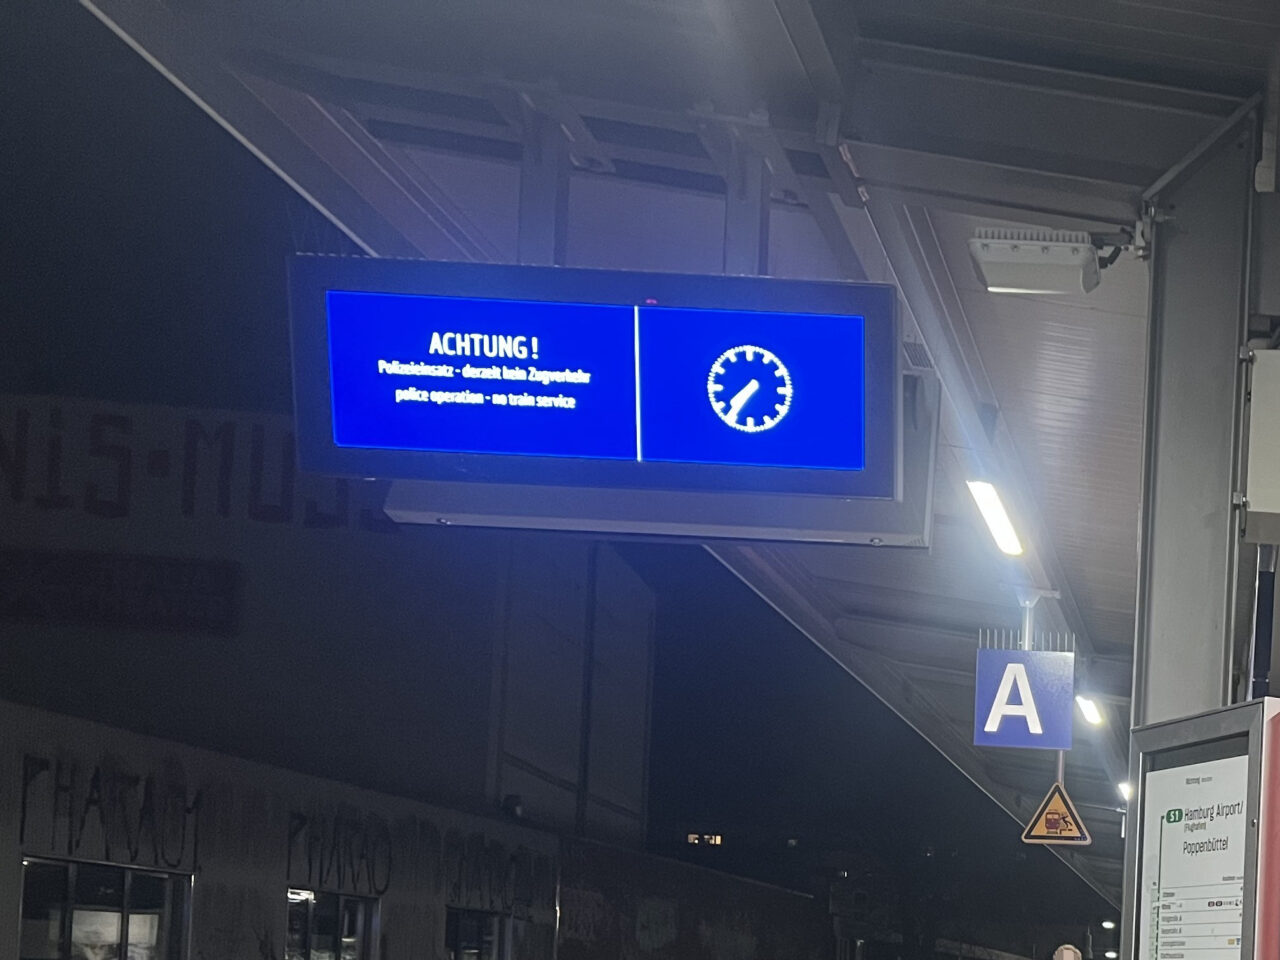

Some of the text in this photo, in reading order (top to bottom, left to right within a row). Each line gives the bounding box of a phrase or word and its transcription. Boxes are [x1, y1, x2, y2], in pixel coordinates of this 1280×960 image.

[429, 332, 528, 359] ACHTUNG
[378, 359, 454, 377] Polizeieinsatz
[462, 363, 502, 380] derzeit
[502, 365, 527, 381] kein
[527, 366, 591, 385] Zugverkehr
[395, 387, 429, 403] police
[429, 390, 484, 404] operation
[492, 393, 508, 406] no
[508, 393, 535, 407] train
[535, 394, 576, 409] service
[983, 663, 1043, 734] A
[1184, 804, 1215, 821] Hamburg
[1215, 800, 1244, 820] Airport/
[1182, 836, 1229, 856] Poppenbüttel
